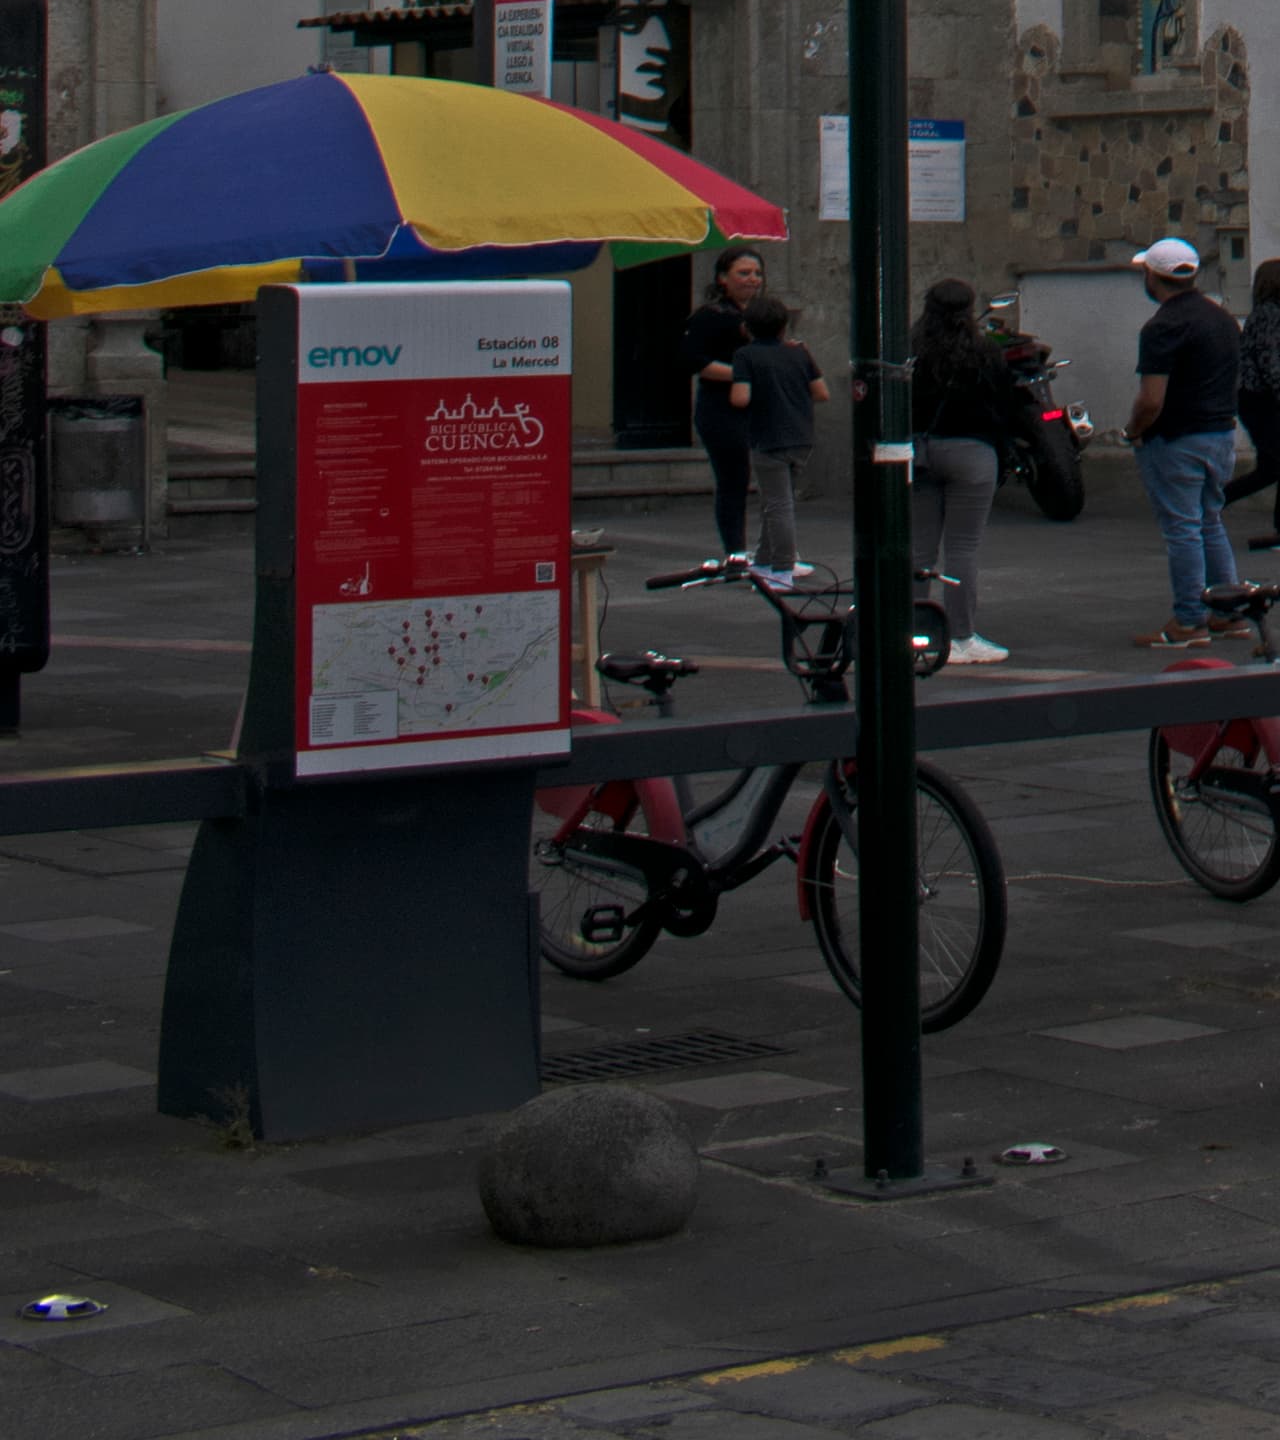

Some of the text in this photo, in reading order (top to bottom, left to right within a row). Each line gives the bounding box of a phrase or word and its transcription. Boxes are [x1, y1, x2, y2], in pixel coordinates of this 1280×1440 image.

[478, 336, 560, 351] Estación 08
[308, 344, 402, 368] emov
[493, 355, 559, 368] La Merced
[425, 433, 521, 451] CUENCA
